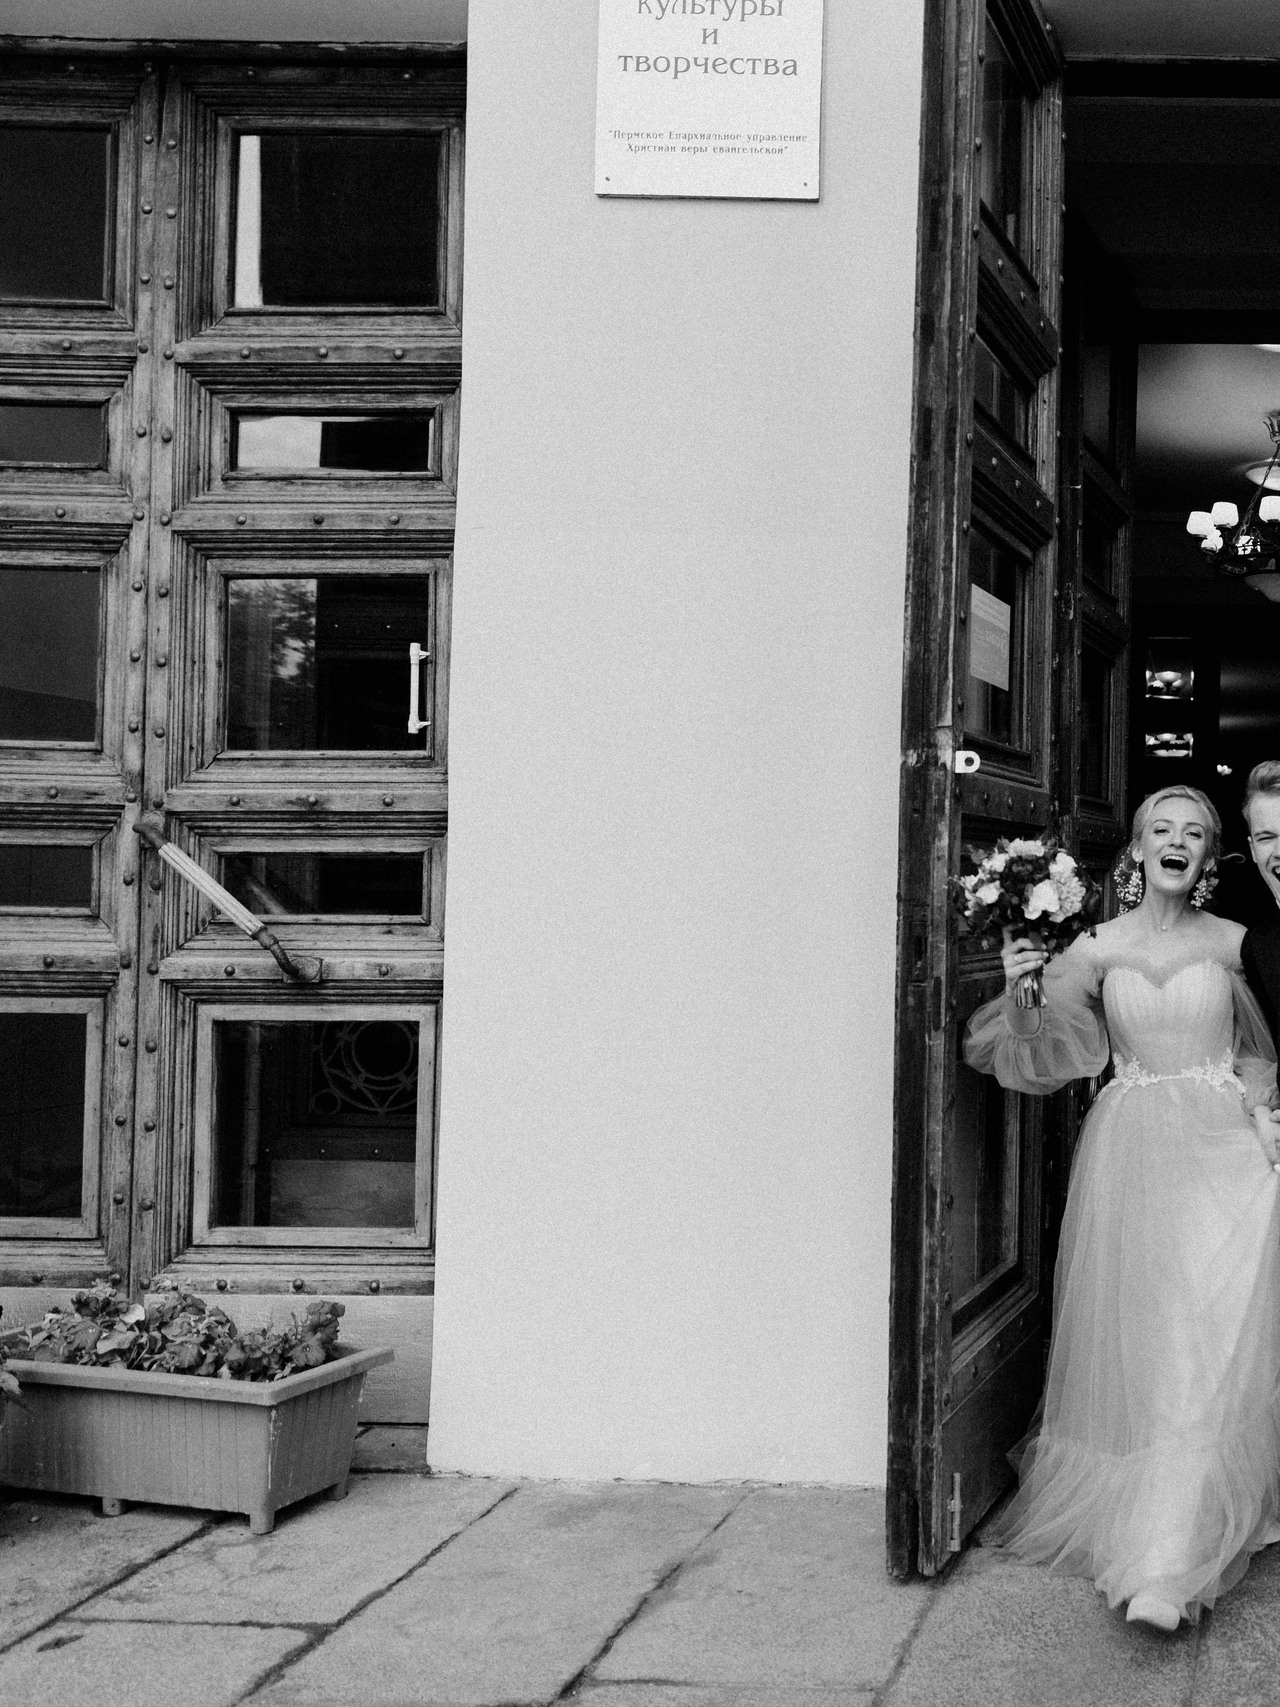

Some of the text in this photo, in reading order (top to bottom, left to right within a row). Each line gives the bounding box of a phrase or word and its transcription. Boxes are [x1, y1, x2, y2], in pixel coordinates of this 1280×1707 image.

[637, 0, 783, 22] культуры
[701, 28, 719, 45] и
[617, 55, 798, 80] творчества
[668, 131, 742, 143] Епархиальное
[747, 134, 808, 144] управление
[626, 143, 676, 154] Христиан
[681, 145, 708, 155] веры
